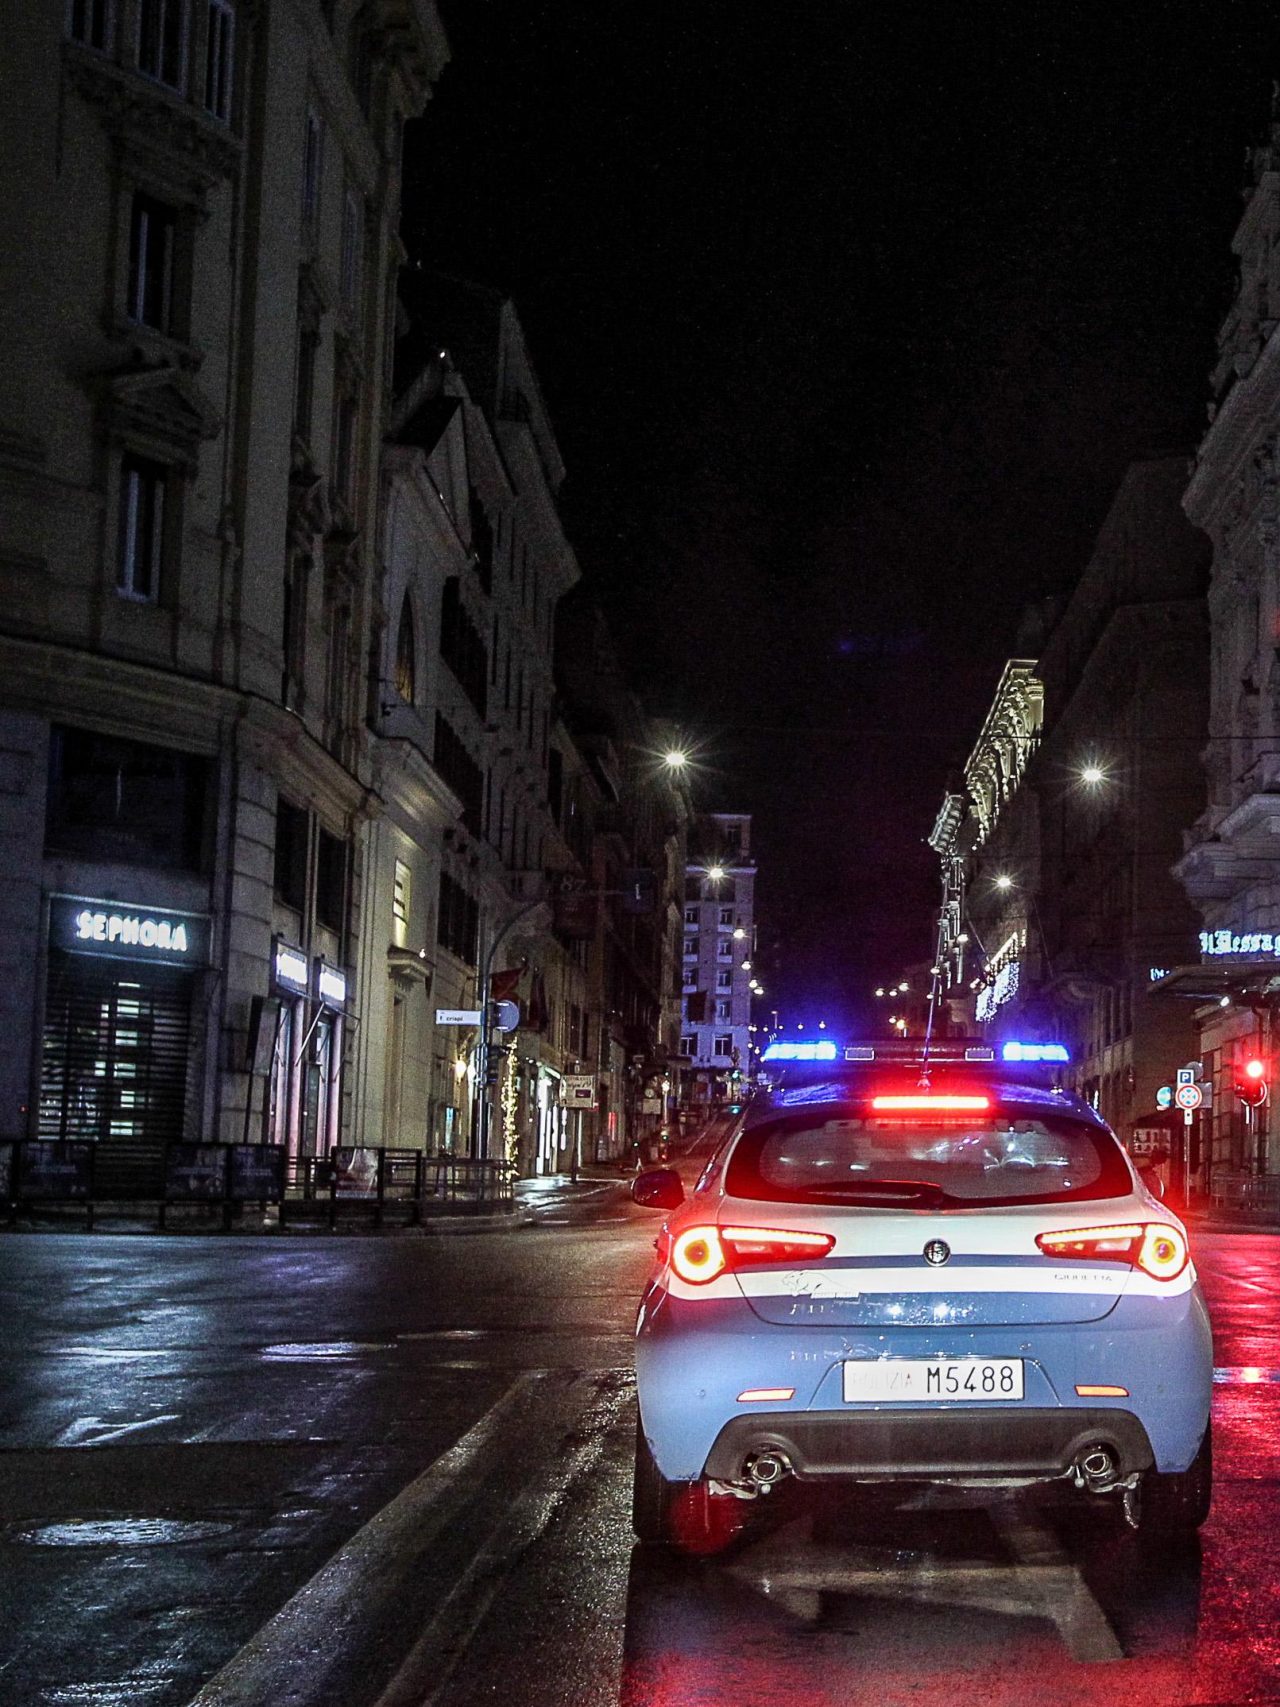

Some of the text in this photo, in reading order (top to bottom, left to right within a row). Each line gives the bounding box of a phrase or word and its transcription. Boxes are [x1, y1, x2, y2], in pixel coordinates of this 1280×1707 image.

[76, 910, 187, 952] SEPHORA
[1181, 1073, 1190, 1083] P
[927, 1366, 1013, 1393] M5488
